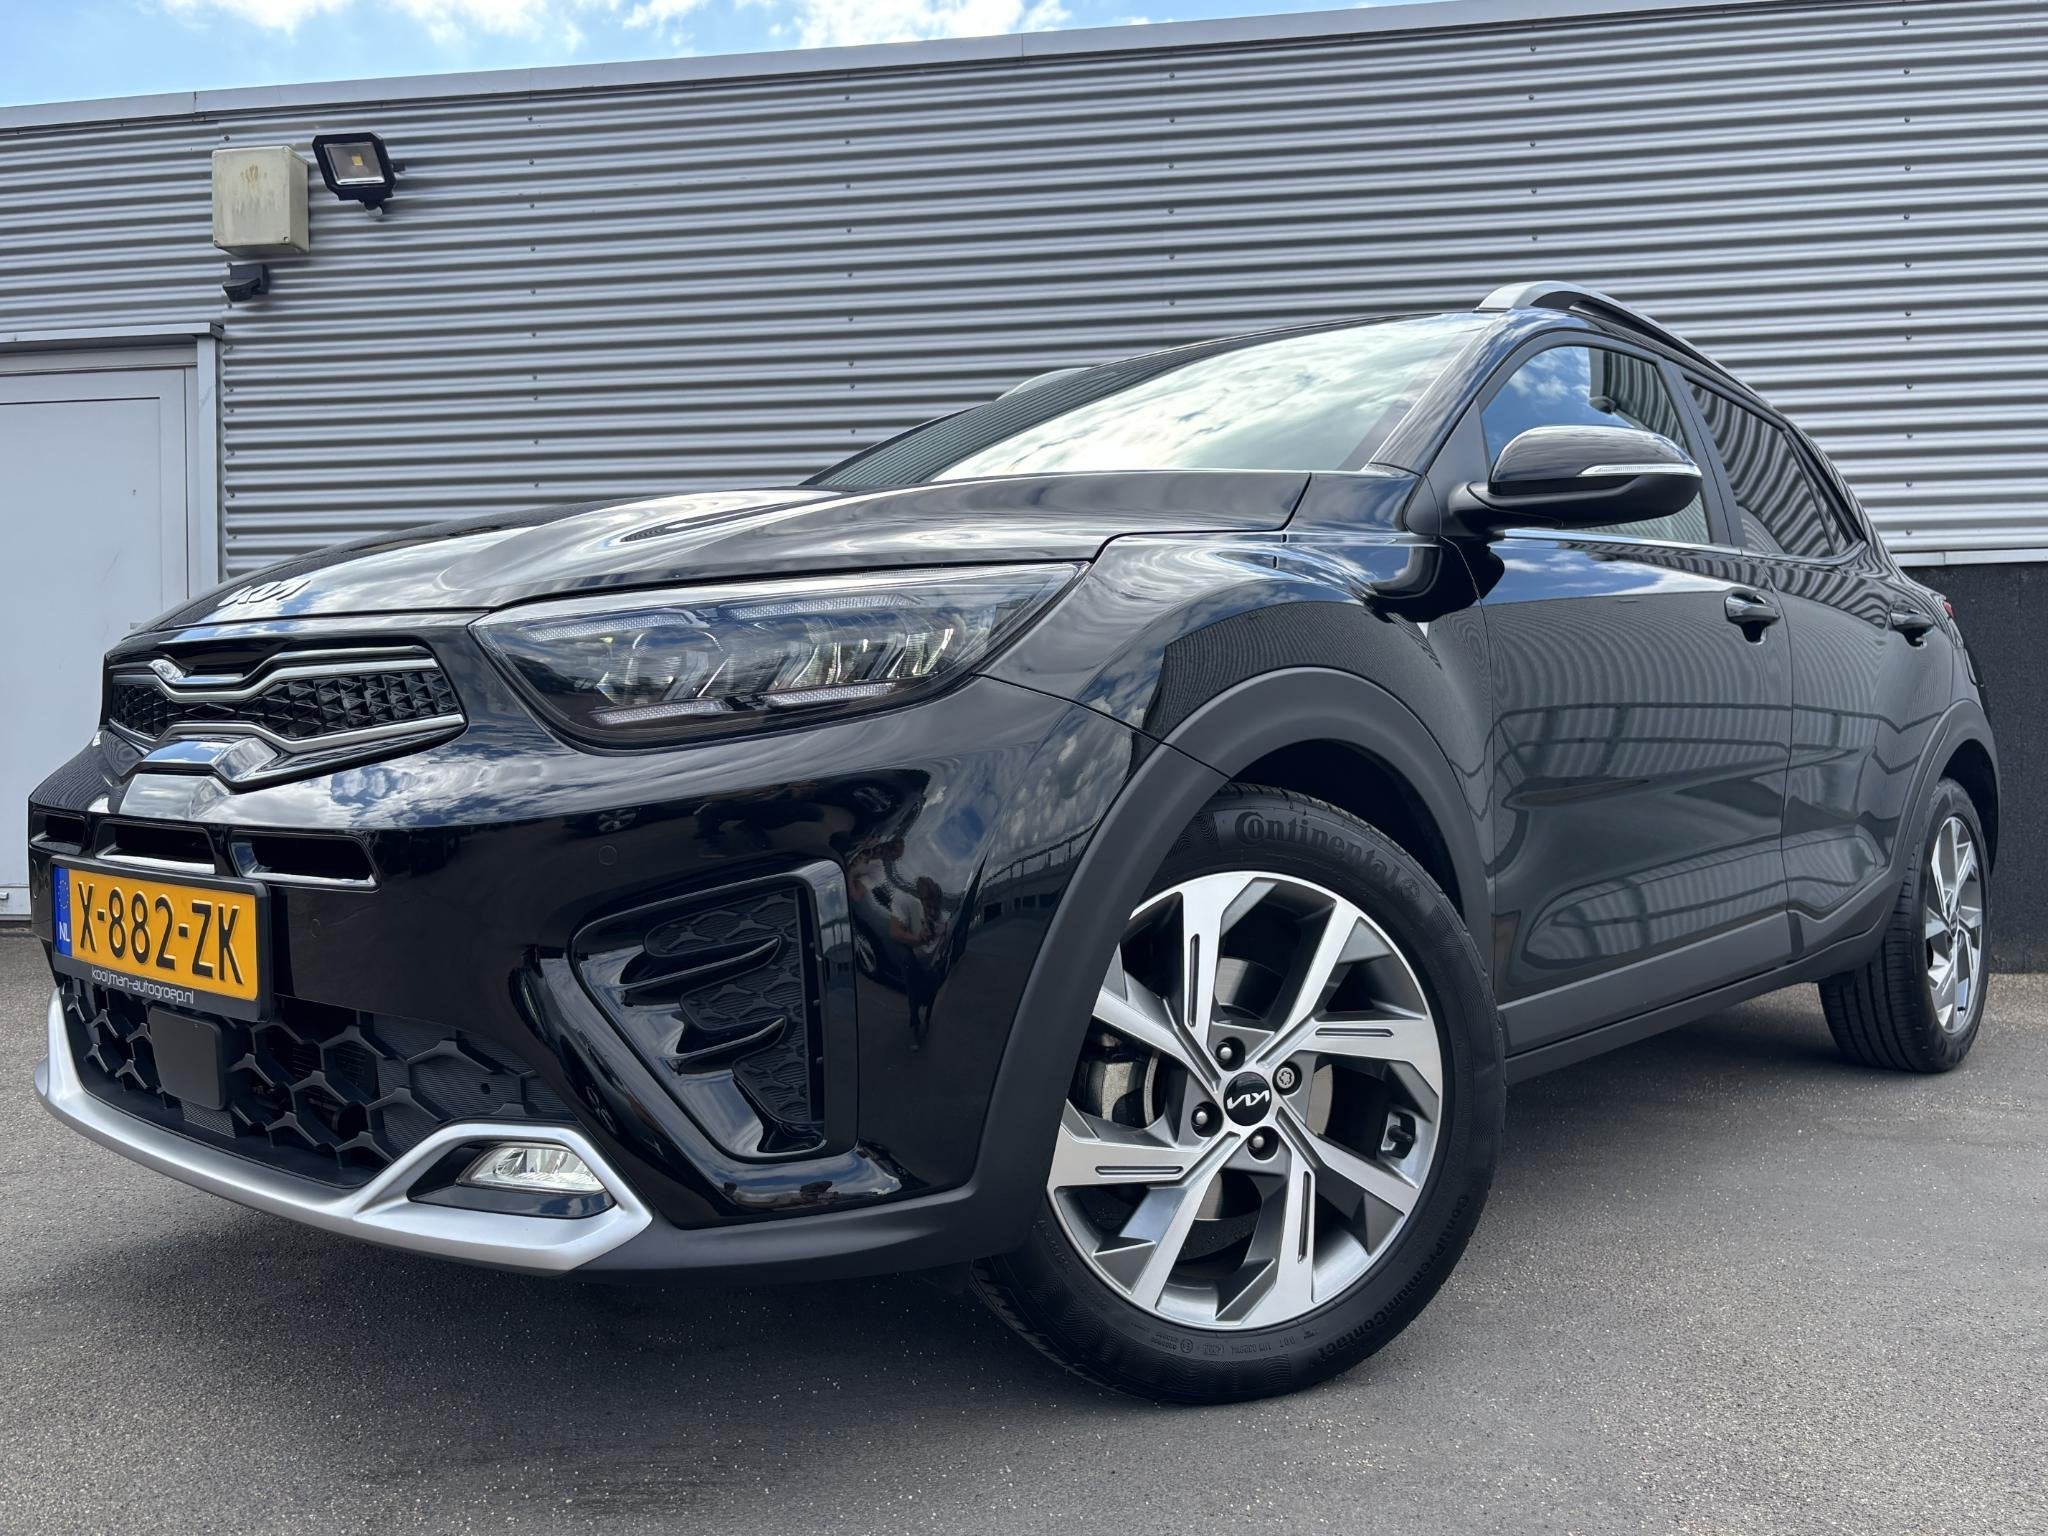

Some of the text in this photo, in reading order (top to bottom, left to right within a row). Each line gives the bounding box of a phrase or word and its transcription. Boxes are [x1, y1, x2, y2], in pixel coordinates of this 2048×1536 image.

[1234, 811, 1401, 893] Continental
[59, 921, 71, 942] NL
[78, 881, 244, 985] X-882-ZK
[91, 966, 194, 1004] kooijman-autogroep.nl
